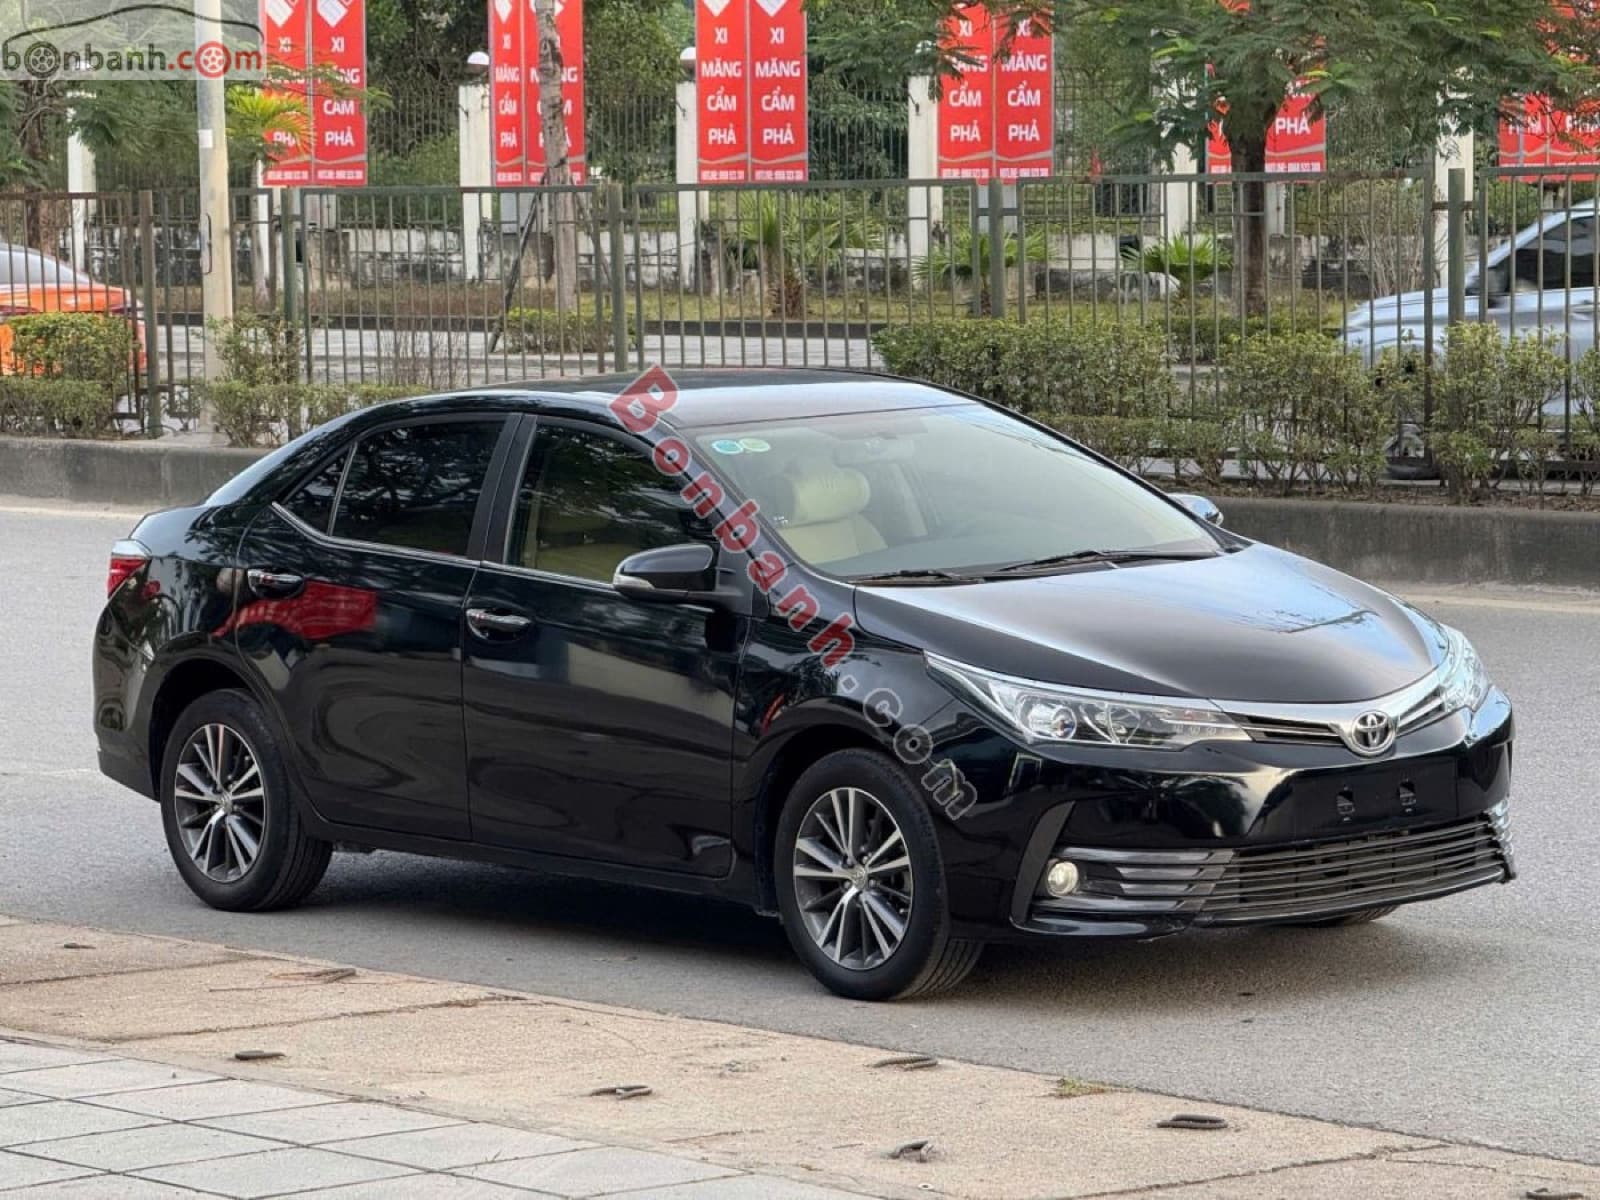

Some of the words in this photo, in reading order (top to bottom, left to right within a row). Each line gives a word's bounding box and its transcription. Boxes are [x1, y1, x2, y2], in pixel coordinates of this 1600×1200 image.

[713, 27, 728, 44] XI
[769, 27, 785, 44] XI
[959, 19, 972, 37] XI
[330, 36, 345, 53] XI
[701, 57, 743, 78] MĂNG
[755, 57, 802, 78] MĂNG
[1001, 50, 1048, 72] MĂNG
[706, 85, 738, 111] CẨM
[761, 85, 796, 111] CẨM
[949, 80, 982, 107] CẨM
[1007, 80, 1041, 107] CẨM
[707, 122, 737, 145] PHẢ
[762, 122, 796, 145] PHẢ
[950, 119, 981, 142] PHẢ
[1008, 118, 1041, 142] PHẢ
[1275, 110, 1312, 135] PHẢ
[324, 125, 356, 147] PHẢ
